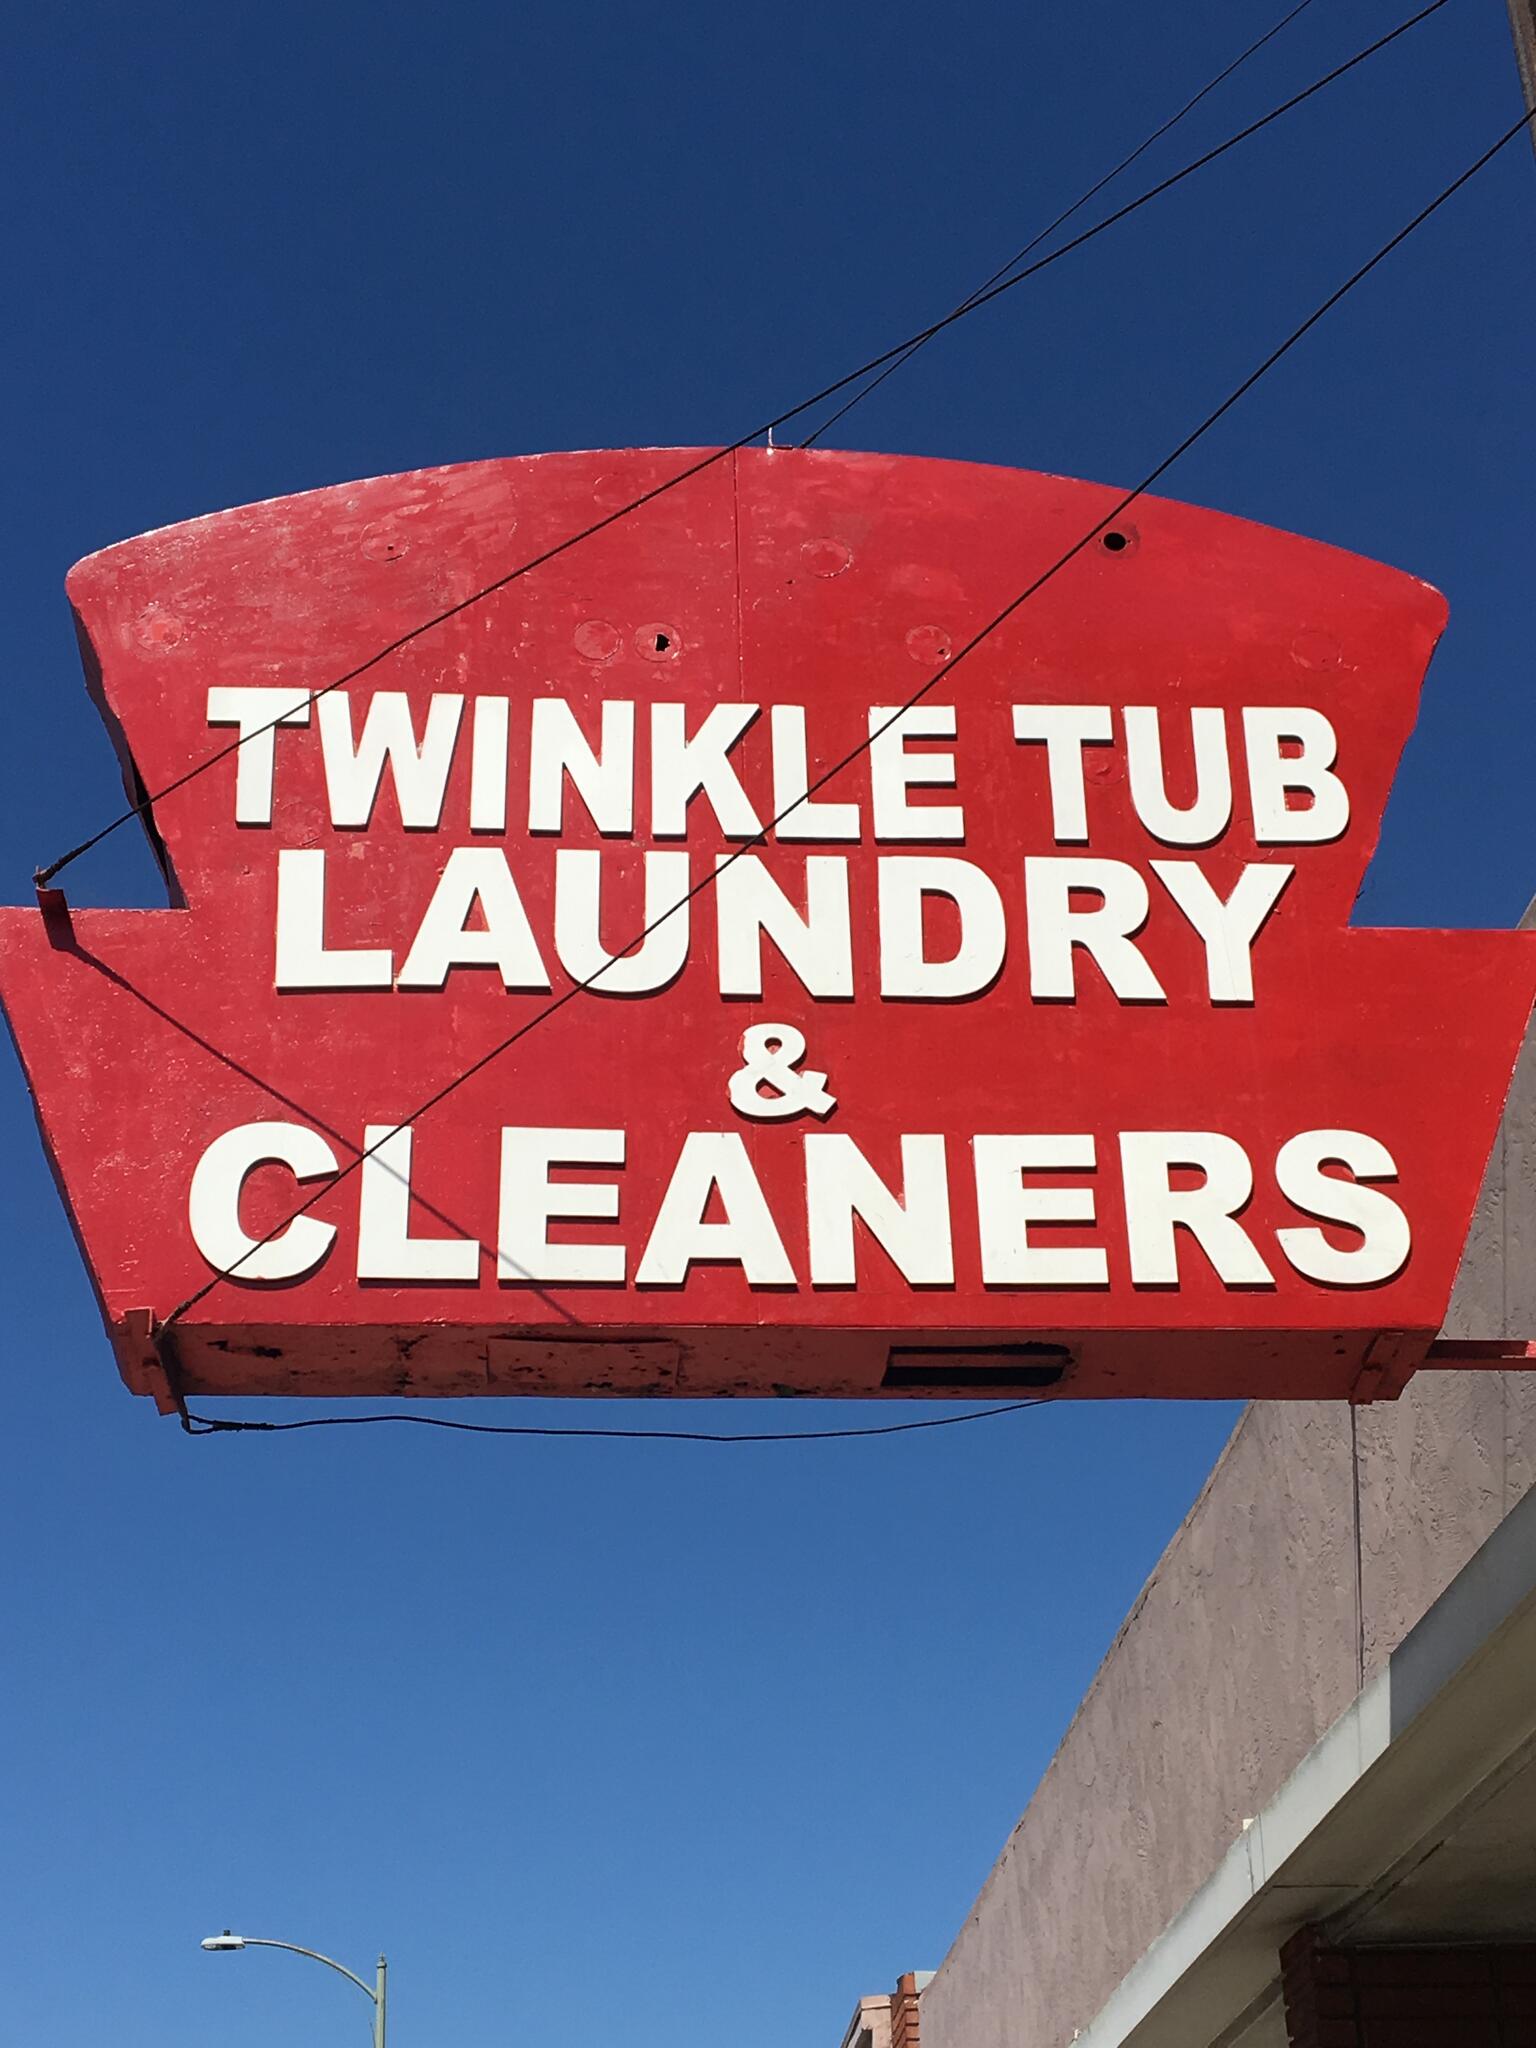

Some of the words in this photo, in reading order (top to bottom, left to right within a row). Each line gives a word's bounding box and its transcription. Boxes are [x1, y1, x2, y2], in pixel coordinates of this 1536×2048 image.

[206, 686, 966, 841] TWINKLE
[1012, 704, 1350, 845] TUB
[273, 847, 1295, 1003] LAUNDRY
[728, 1023, 837, 1118] &
[188, 1121, 1412, 1286] CLEANERS
